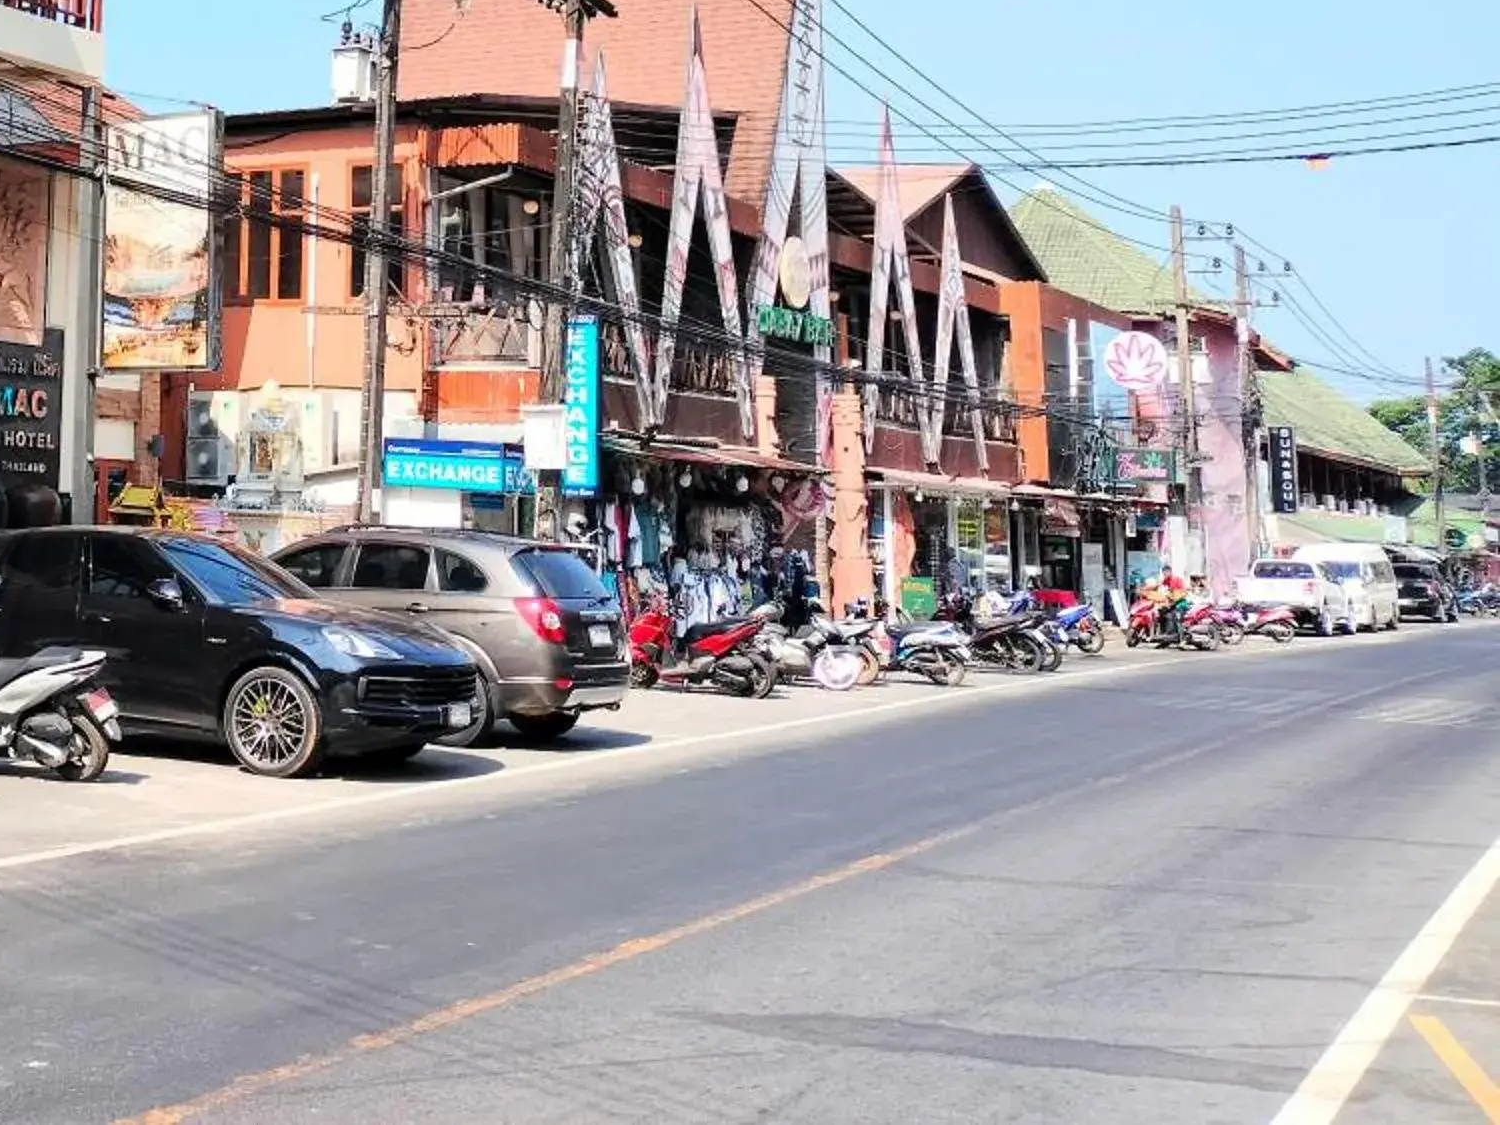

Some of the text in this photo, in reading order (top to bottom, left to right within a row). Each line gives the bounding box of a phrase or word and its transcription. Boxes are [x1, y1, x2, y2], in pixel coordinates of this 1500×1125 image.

[567, 328, 589, 483] EXCHANGE
[4, 430, 55, 449] HOTEL
[387, 461, 500, 484] EXCHANGE
